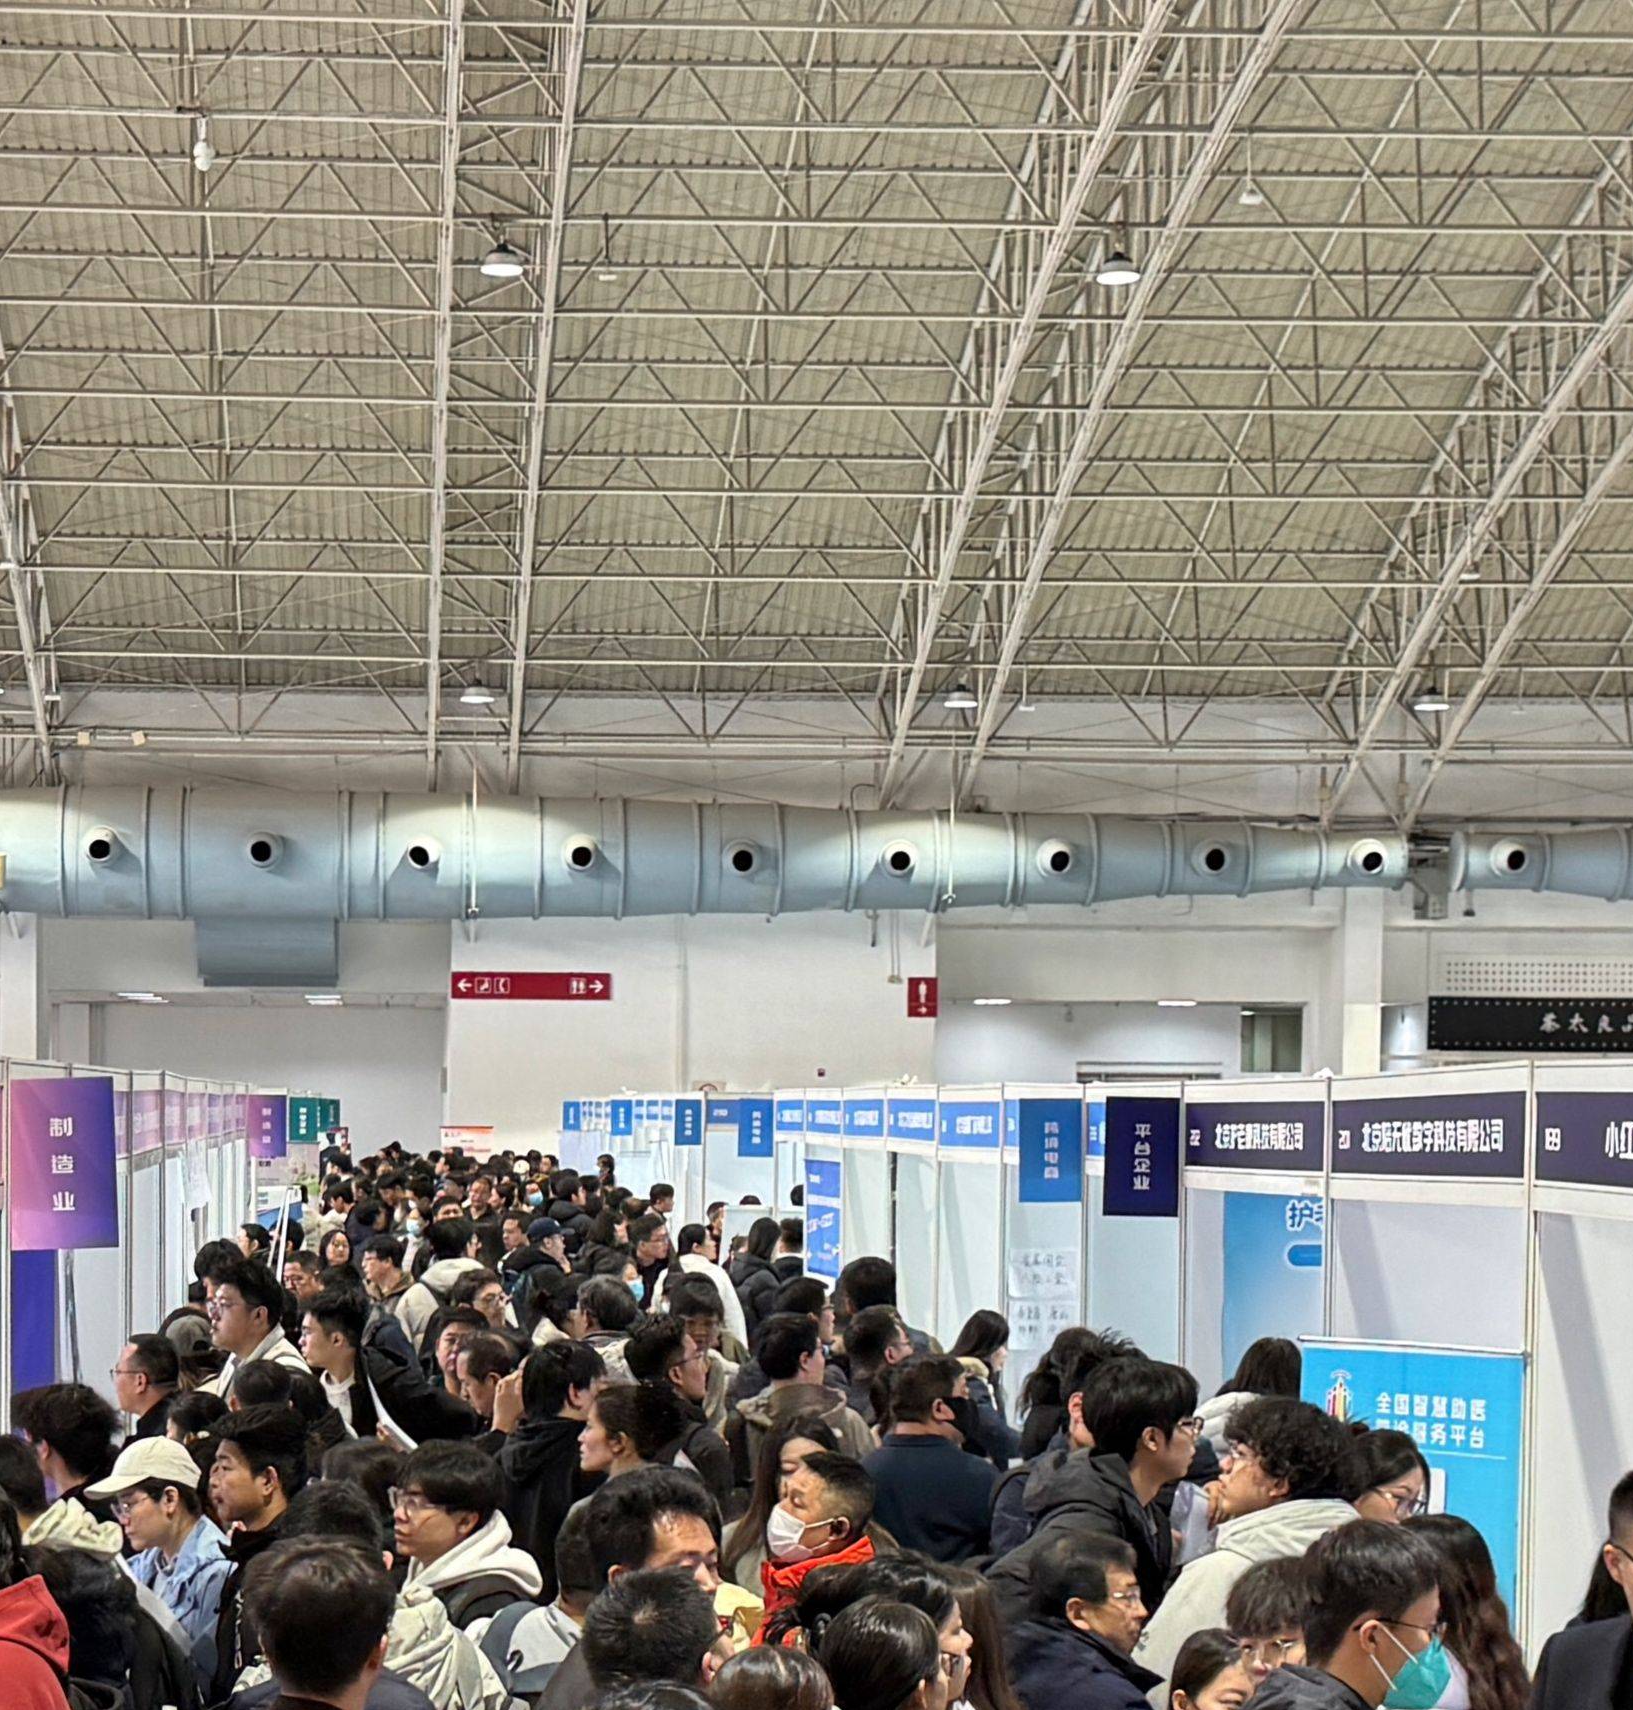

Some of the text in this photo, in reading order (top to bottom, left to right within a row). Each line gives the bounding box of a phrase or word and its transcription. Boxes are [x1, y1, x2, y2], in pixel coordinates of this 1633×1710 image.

[48, 1117, 76, 1213] 制造业
[1132, 1123, 1152, 1191] 平台企业
[1375, 1391, 1487, 1421] 全国智慧助医
